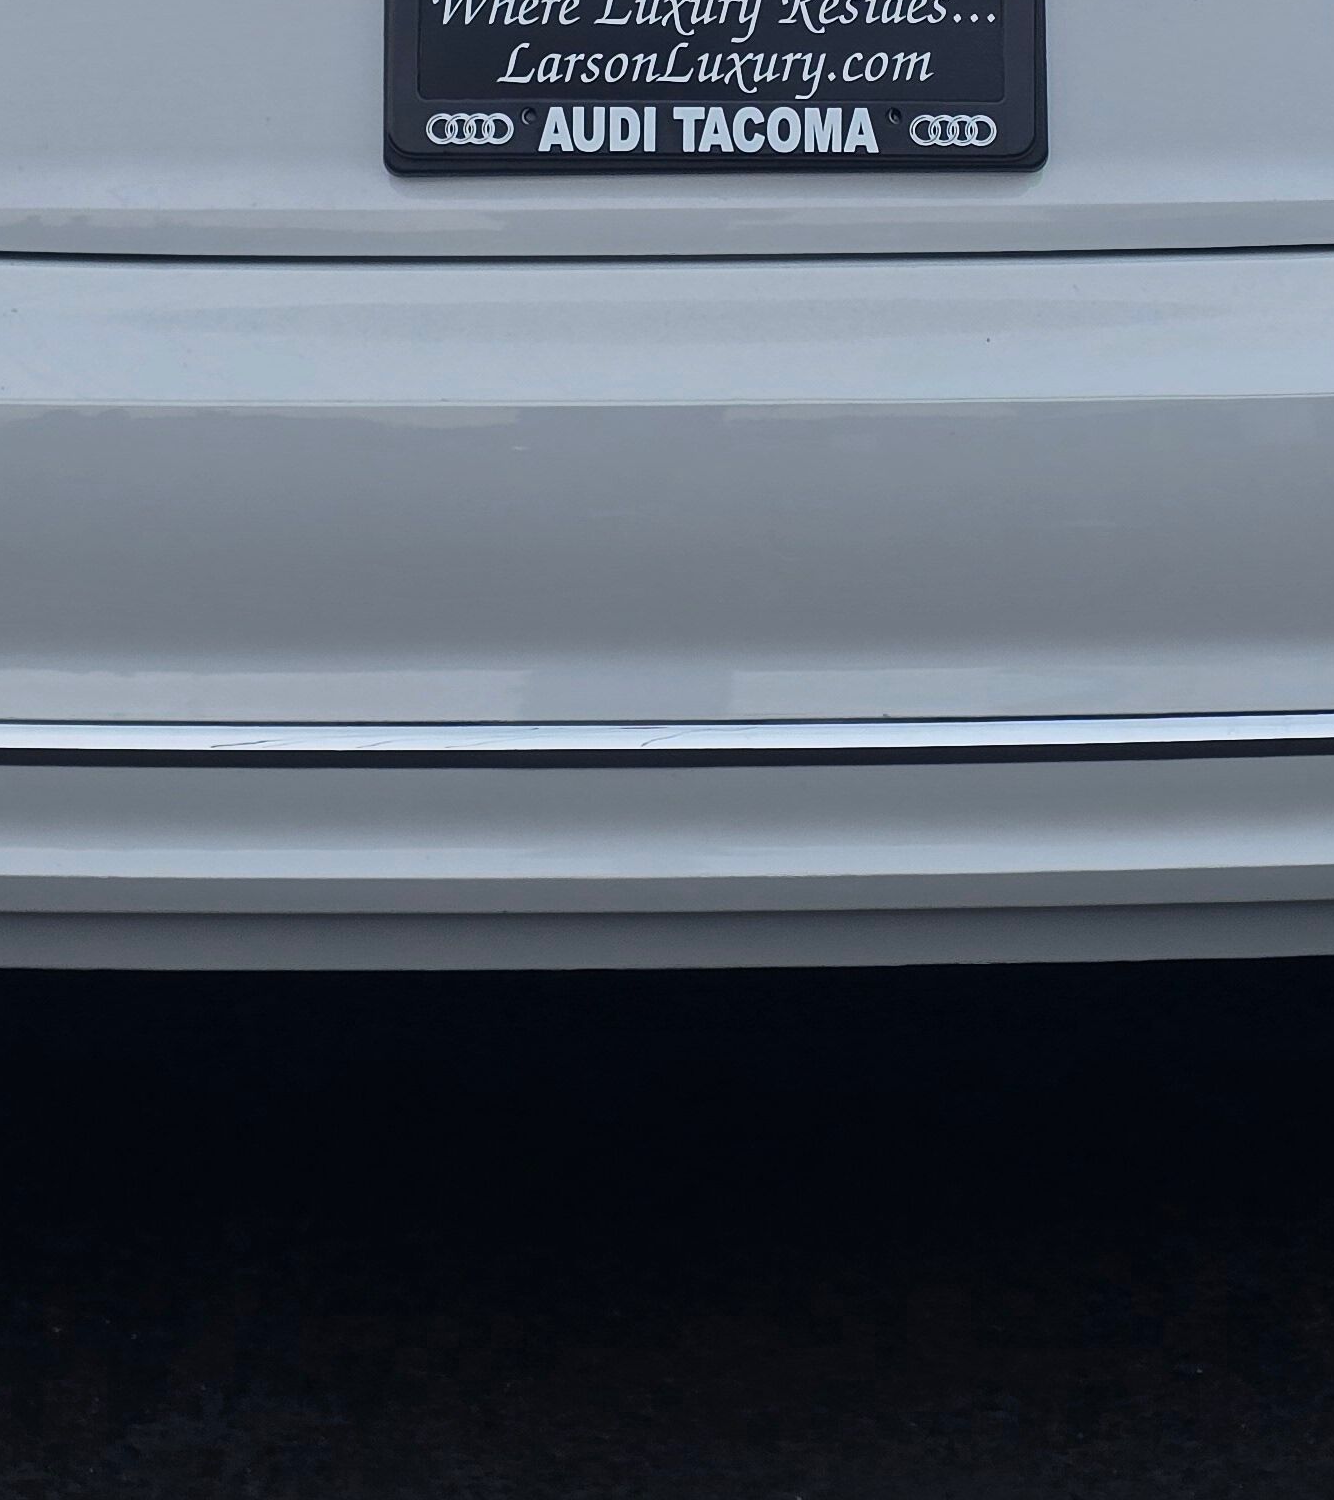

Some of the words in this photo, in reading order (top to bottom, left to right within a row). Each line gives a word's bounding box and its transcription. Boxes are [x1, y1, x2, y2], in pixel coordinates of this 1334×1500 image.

[496, 42, 935, 100] LarsonLuxury.com
[537, 106, 657, 153] AUDI
[672, 106, 880, 154] TACOMA
